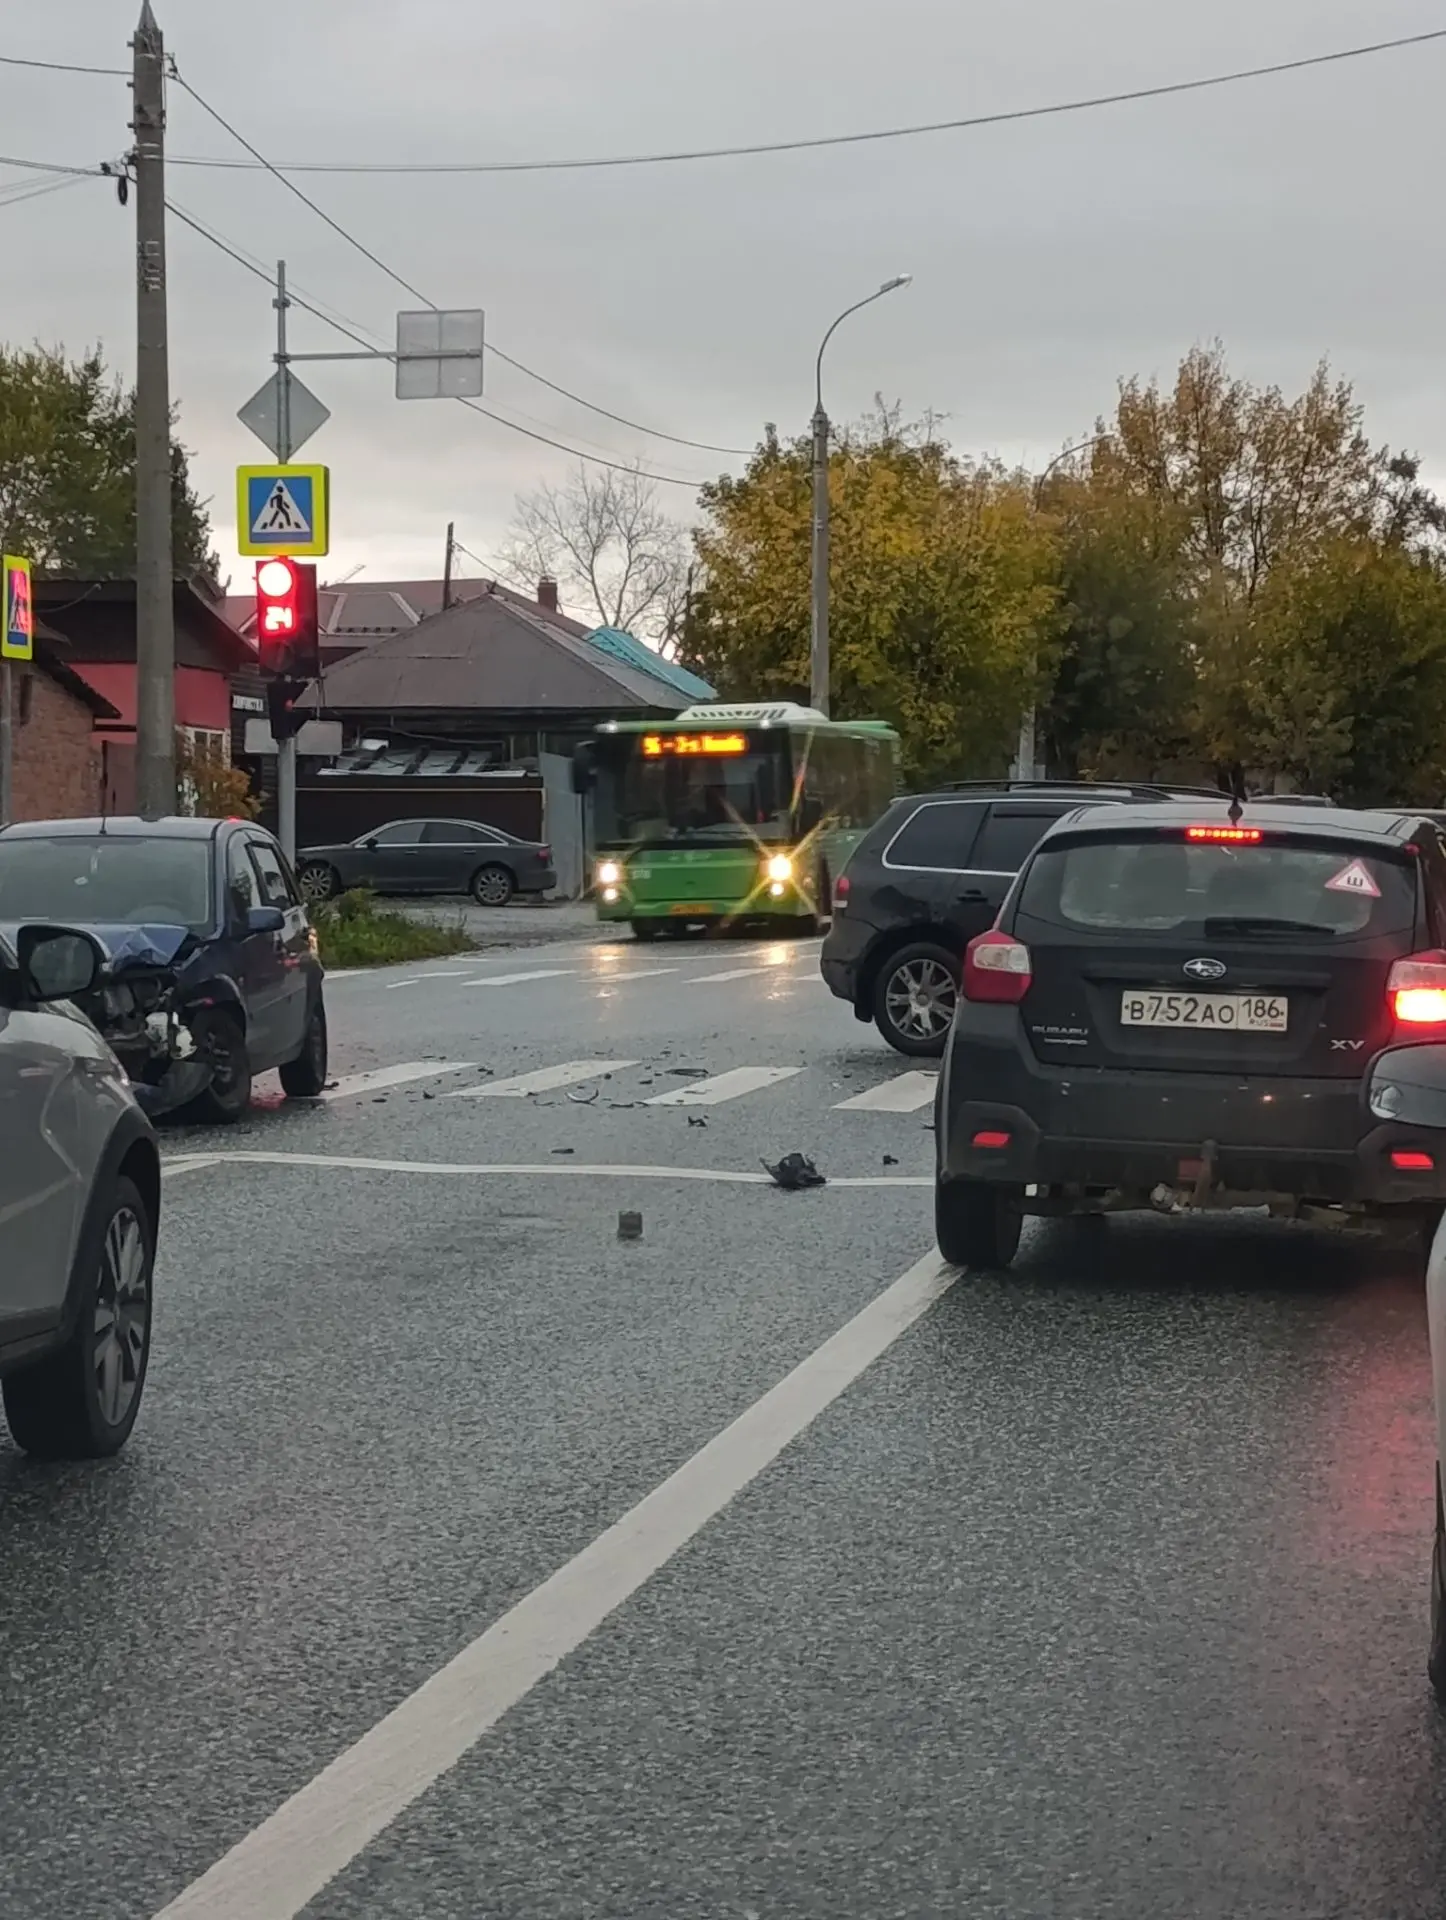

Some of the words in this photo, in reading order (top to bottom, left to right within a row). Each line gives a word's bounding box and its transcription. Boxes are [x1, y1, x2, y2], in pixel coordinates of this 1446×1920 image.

[1347, 875, 1364, 887] Ш
[1130, 996, 1234, 1024] В752АО
[1242, 999, 1280, 1018] 186
[1330, 1039, 1365, 1050] XV
